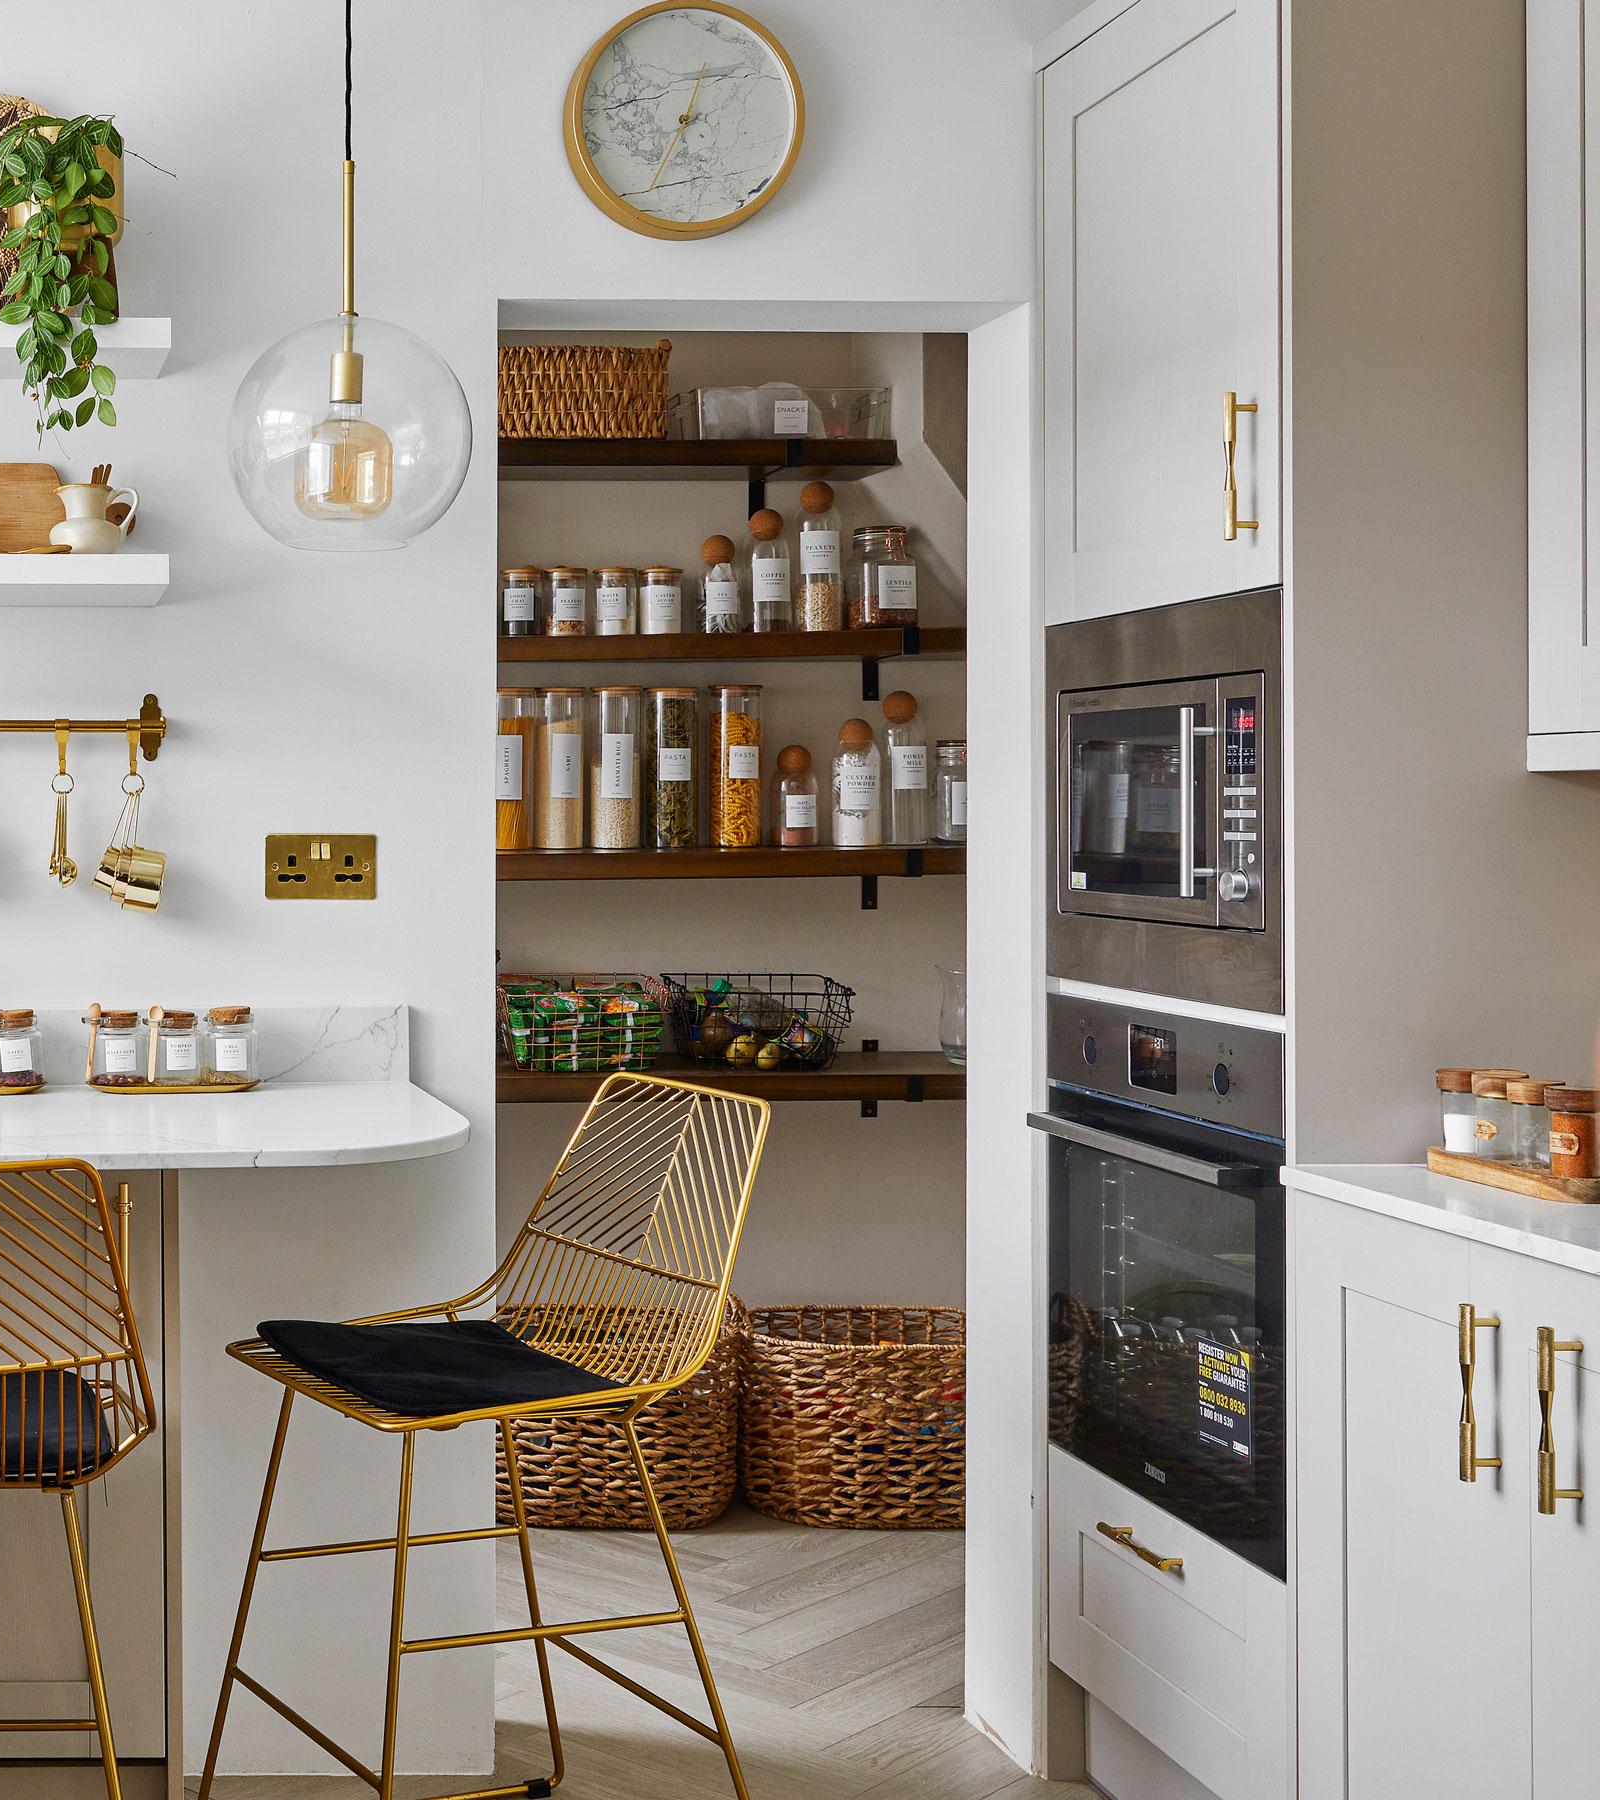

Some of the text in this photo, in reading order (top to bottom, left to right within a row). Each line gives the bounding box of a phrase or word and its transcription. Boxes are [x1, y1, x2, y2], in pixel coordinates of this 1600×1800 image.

[1198, 1341, 1239, 1366] REGISTER NOW
[1198, 1354, 1246, 1381] & ACTIVATE YOUR
[1199, 1364, 1247, 1393] FREE GUARANTEE
[1199, 1385, 1215, 1404] 0800
[1216, 1392, 1229, 1410] 032
[1229, 1397, 1246, 1416] 8936
[1199, 1406, 1203, 1416] 1
[1203, 1407, 1214, 1420] 800
[1223, 1415, 1234, 1429] 530
